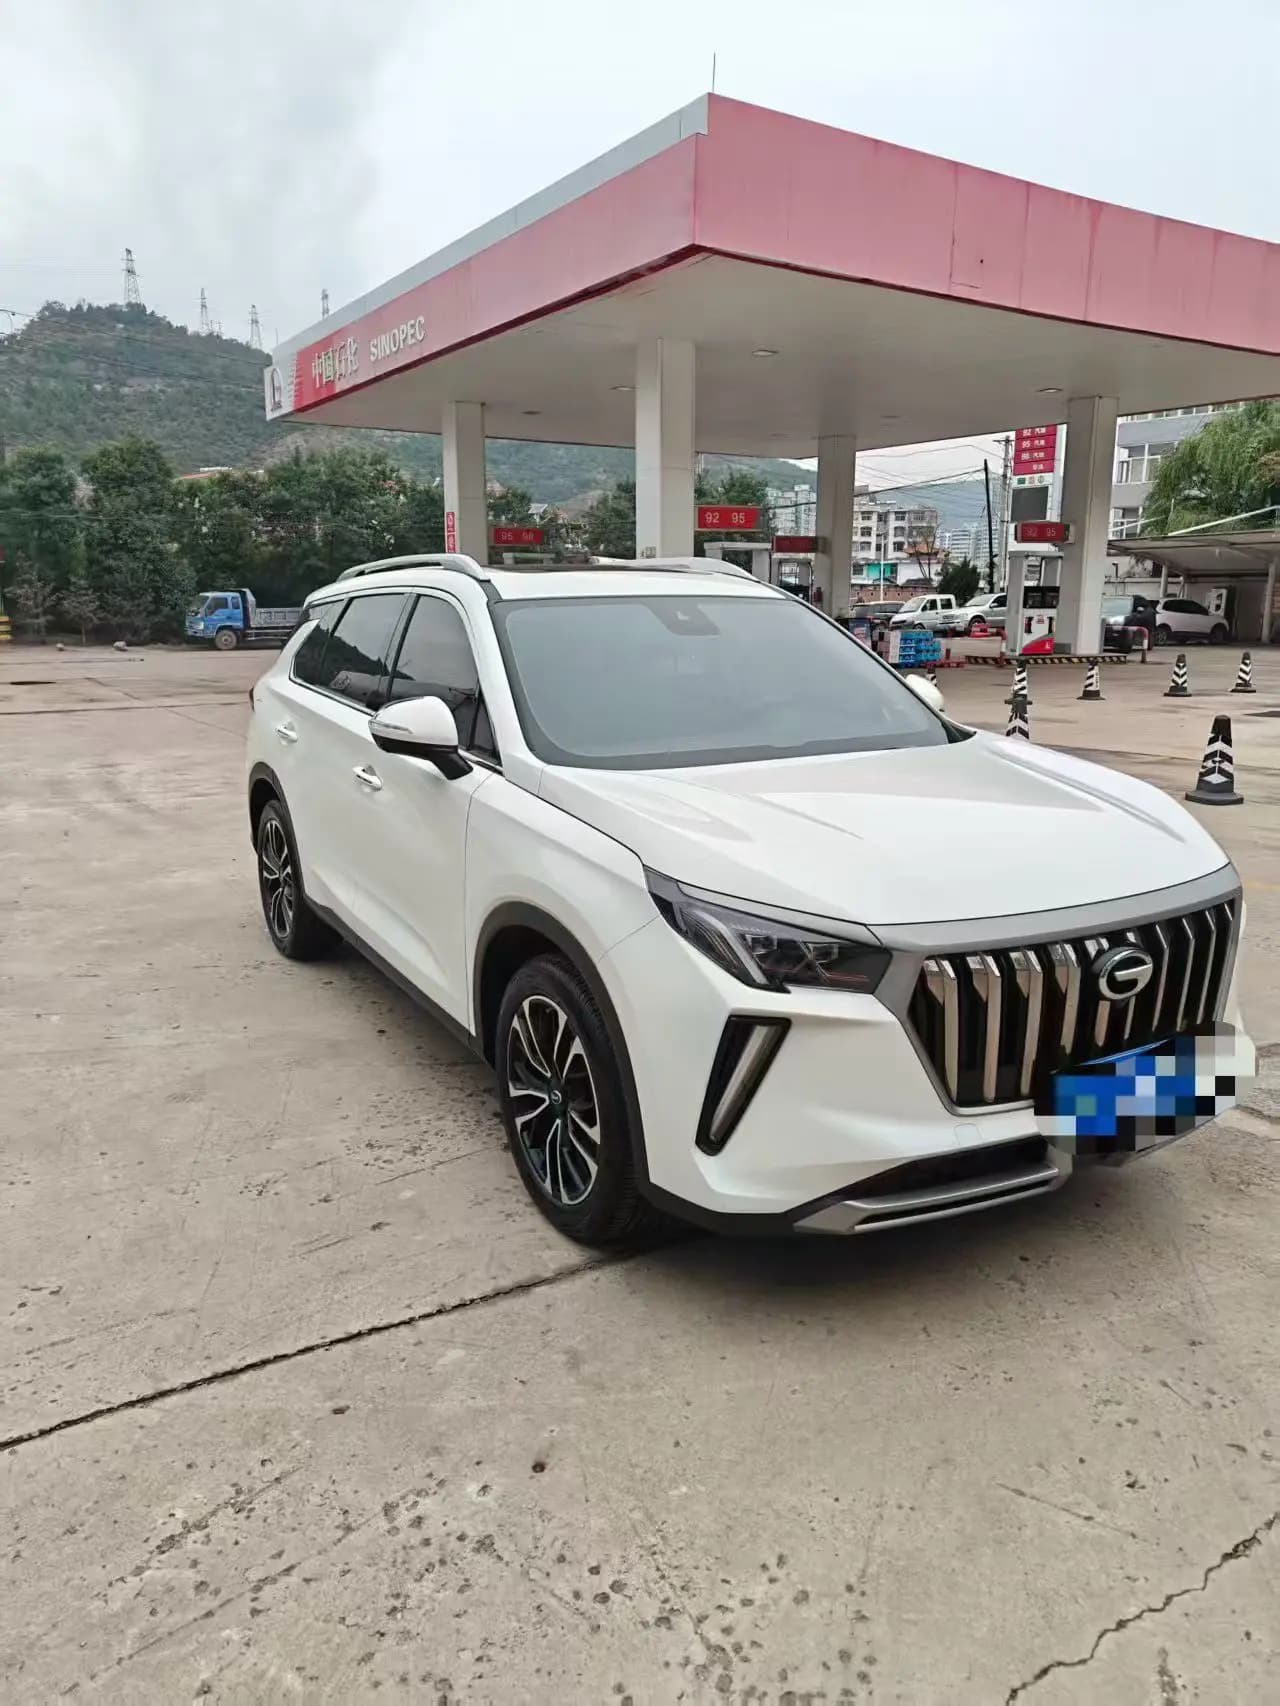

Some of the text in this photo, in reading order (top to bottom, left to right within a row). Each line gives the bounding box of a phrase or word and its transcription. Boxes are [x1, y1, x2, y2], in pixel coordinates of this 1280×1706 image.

[311, 315, 425, 388] 中国石化 SINOPEC
[704, 512, 745, 524] 92 95
